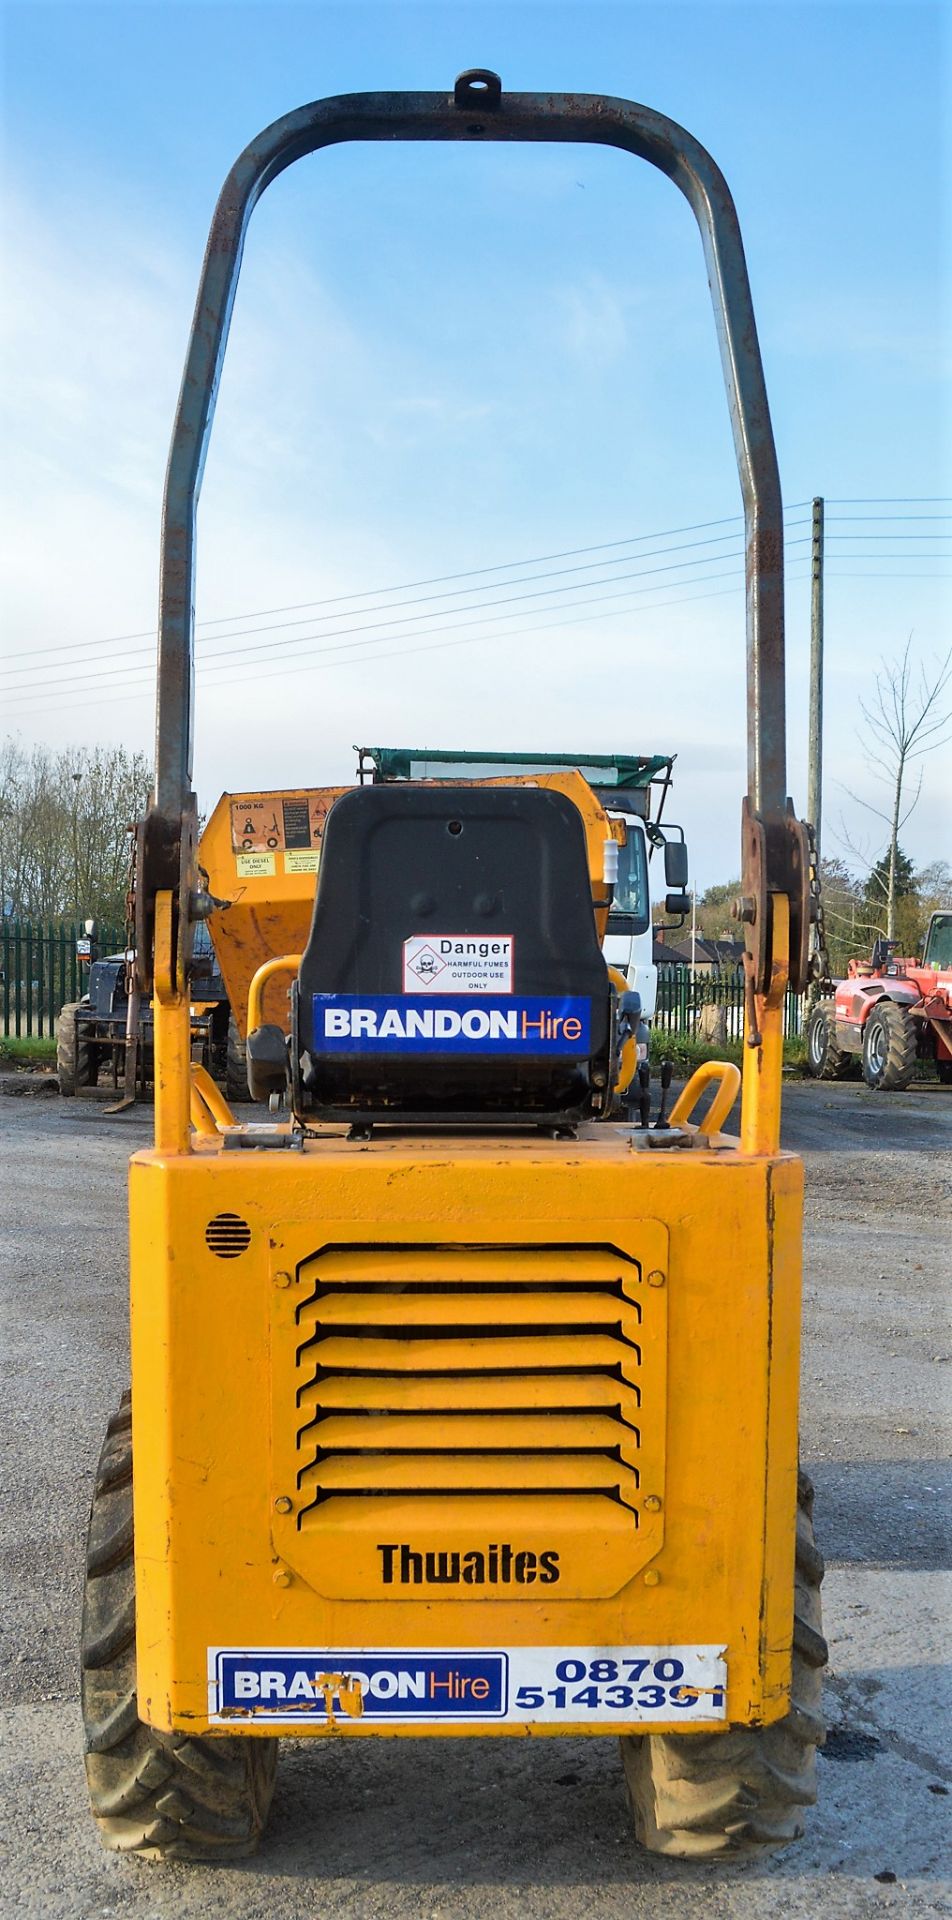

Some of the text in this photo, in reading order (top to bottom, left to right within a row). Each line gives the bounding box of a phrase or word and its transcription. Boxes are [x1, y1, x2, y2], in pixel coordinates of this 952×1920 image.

[440, 940, 510, 957] Danger
[324, 1008, 582, 1040] BRANDON Hire
[376, 1544, 560, 1584] Thwaites
[555, 1658, 684, 1683] 0870
[430, 1671, 490, 1699] Hire
[515, 1684, 724, 1709] 5143391
